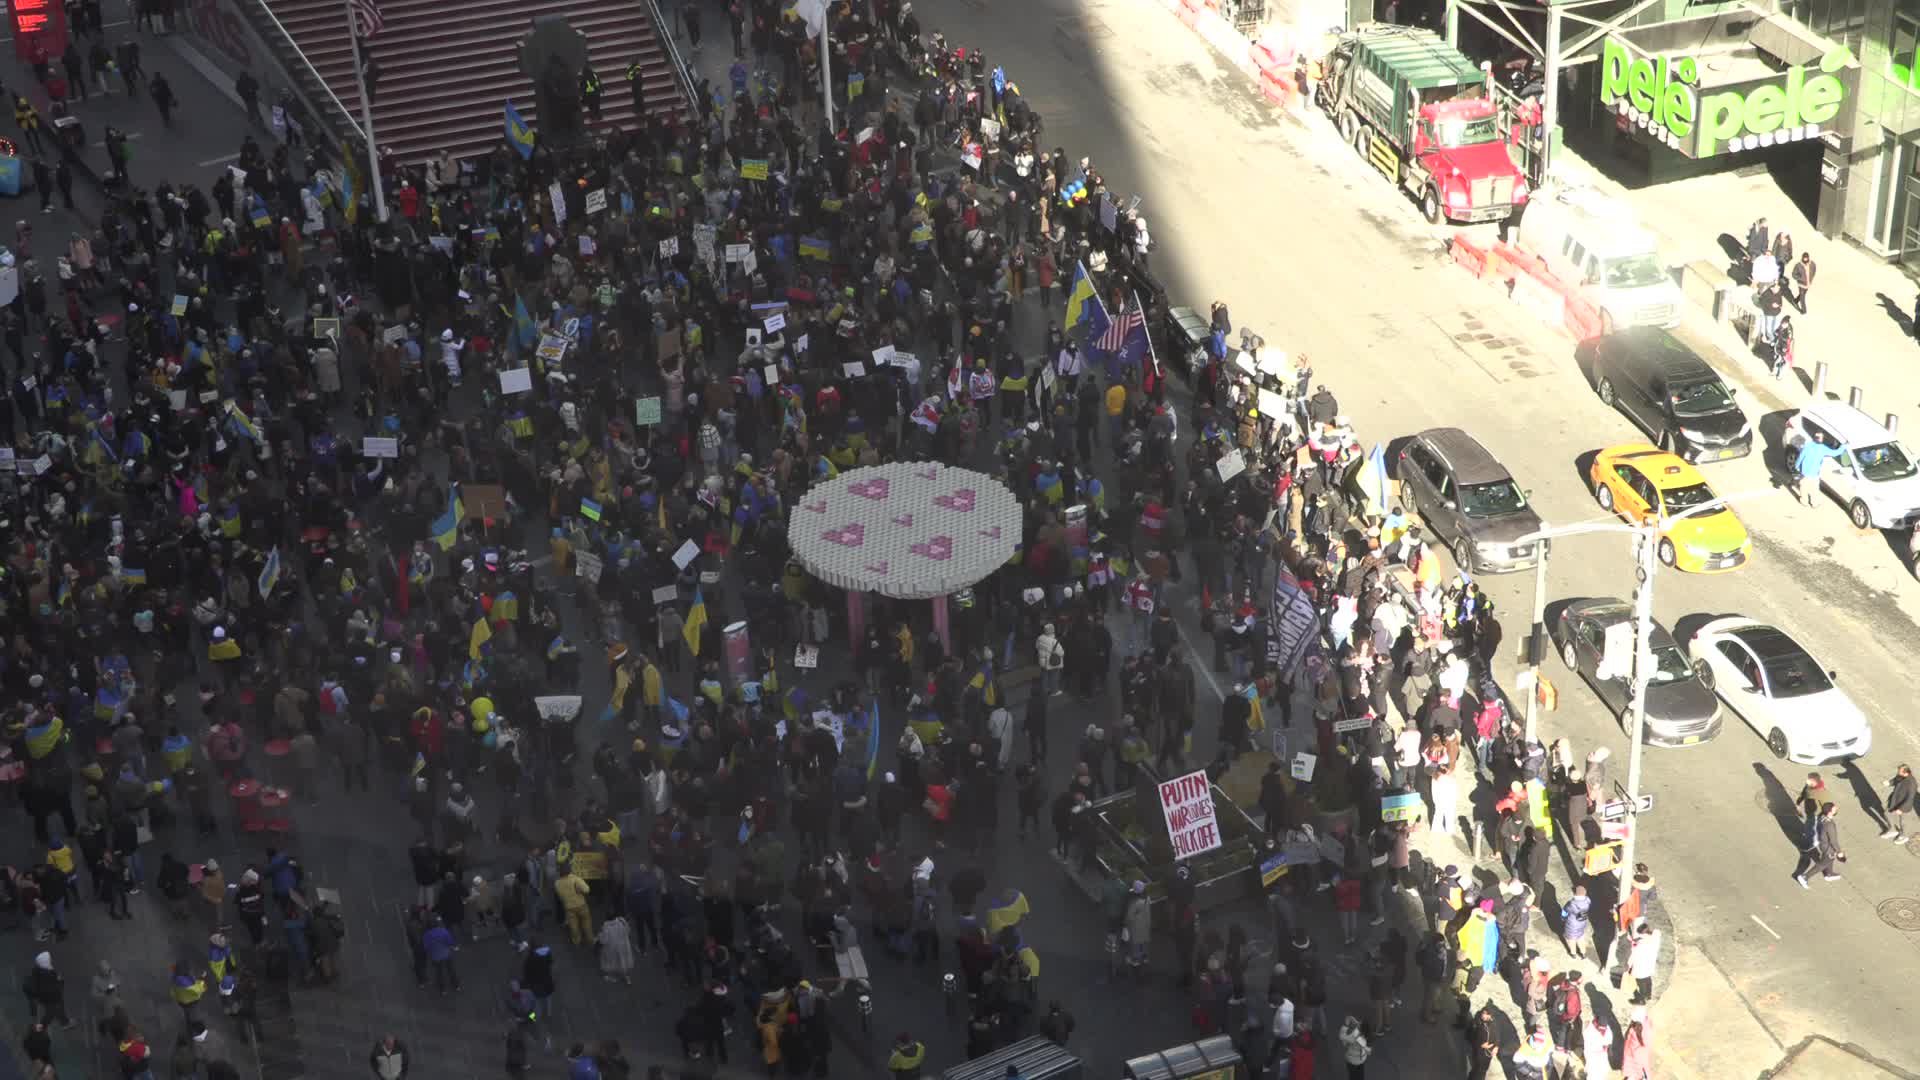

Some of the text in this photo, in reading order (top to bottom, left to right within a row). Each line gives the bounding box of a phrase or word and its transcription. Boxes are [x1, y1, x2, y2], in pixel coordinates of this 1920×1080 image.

[1698, 45, 1850, 158] pelé
[1162, 774, 1207, 807] PUTIN
[1168, 806, 1191, 832] WAR
[1174, 822, 1215, 857] FUCK OFF
